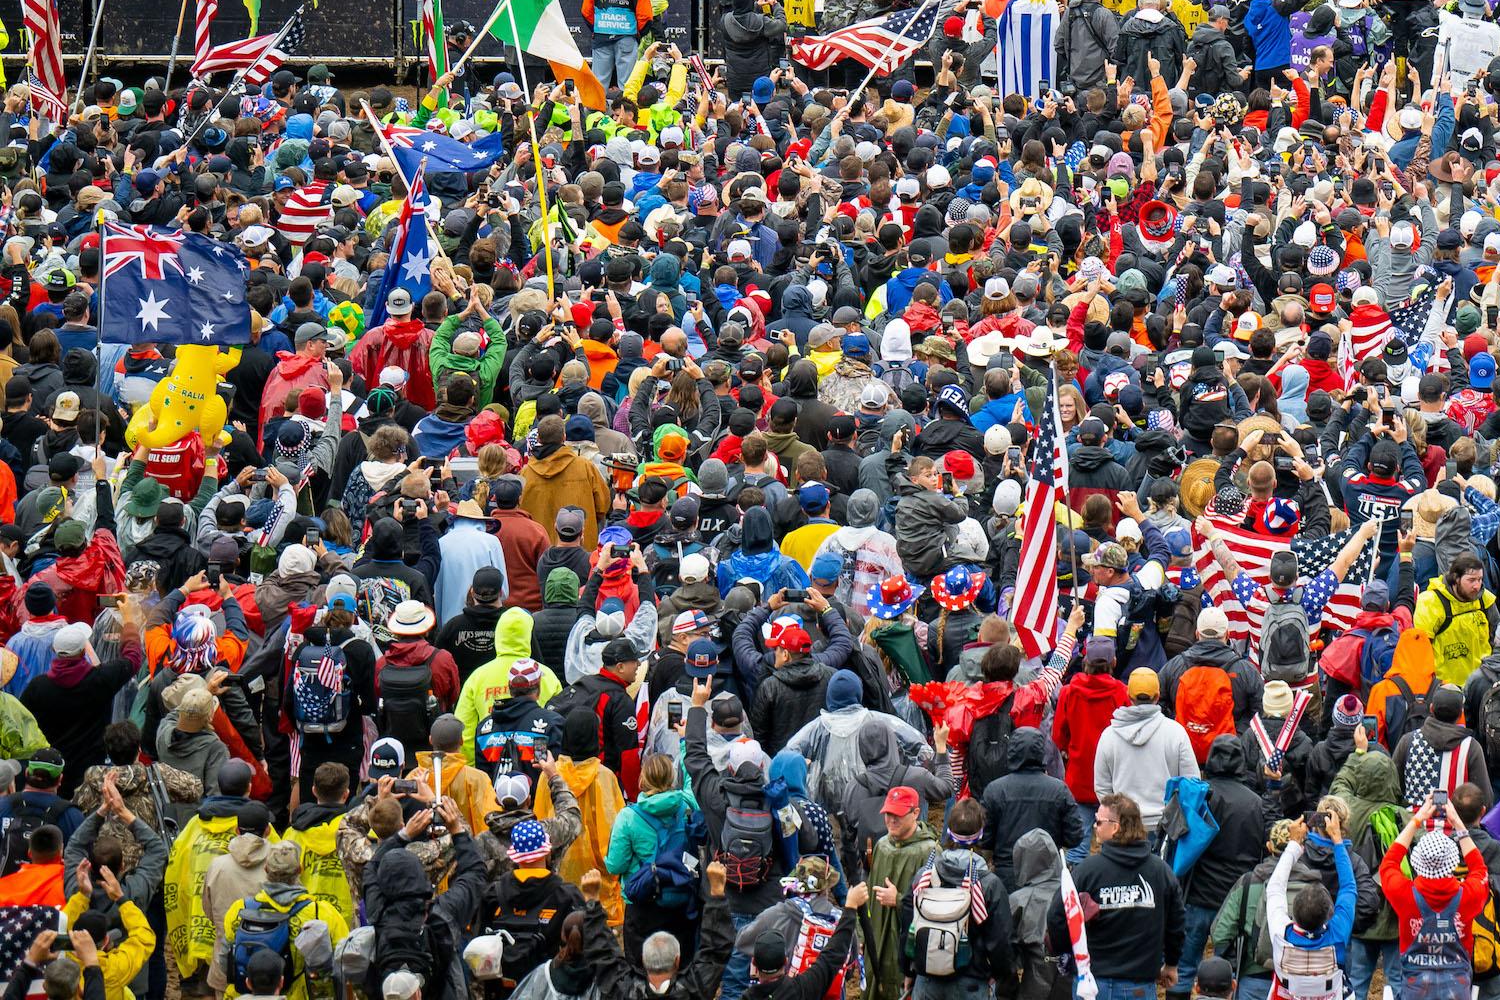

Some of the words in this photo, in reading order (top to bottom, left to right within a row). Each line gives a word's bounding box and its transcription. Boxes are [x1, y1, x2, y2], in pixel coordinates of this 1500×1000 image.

[792, 7, 804, 15] TV
[600, 13, 627, 21] TRACK
[597, 20, 630, 30] SERVICE
[161, 453, 181, 463] SEND
[373, 757, 396, 767] USA
[1100, 885, 1139, 894] SOUTHEAST
[1100, 892, 1139, 904] TURF
[1418, 932, 1456, 944] MADE
[1428, 945, 1441, 954] IN
